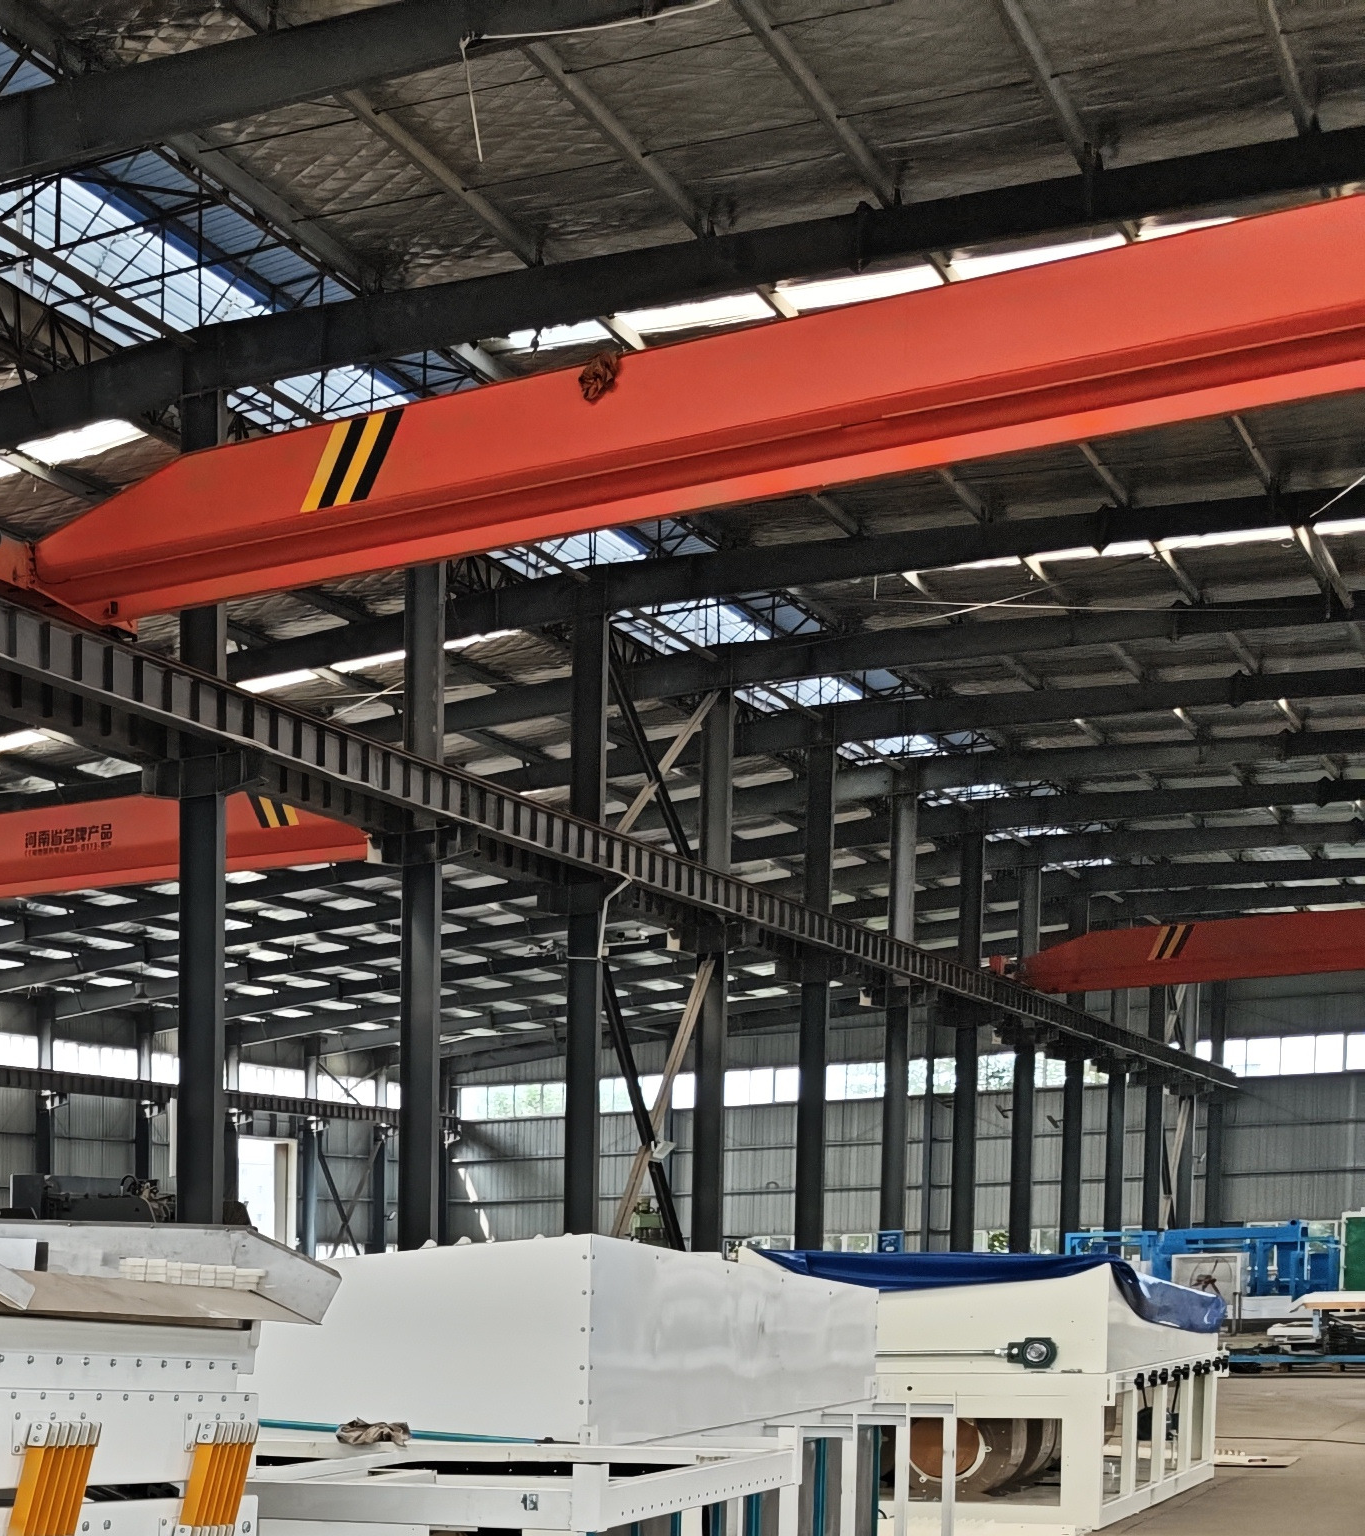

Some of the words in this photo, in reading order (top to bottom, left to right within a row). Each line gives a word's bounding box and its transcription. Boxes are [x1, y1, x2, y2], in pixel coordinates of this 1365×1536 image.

[25, 823, 113, 848] 河南省名牌产品
